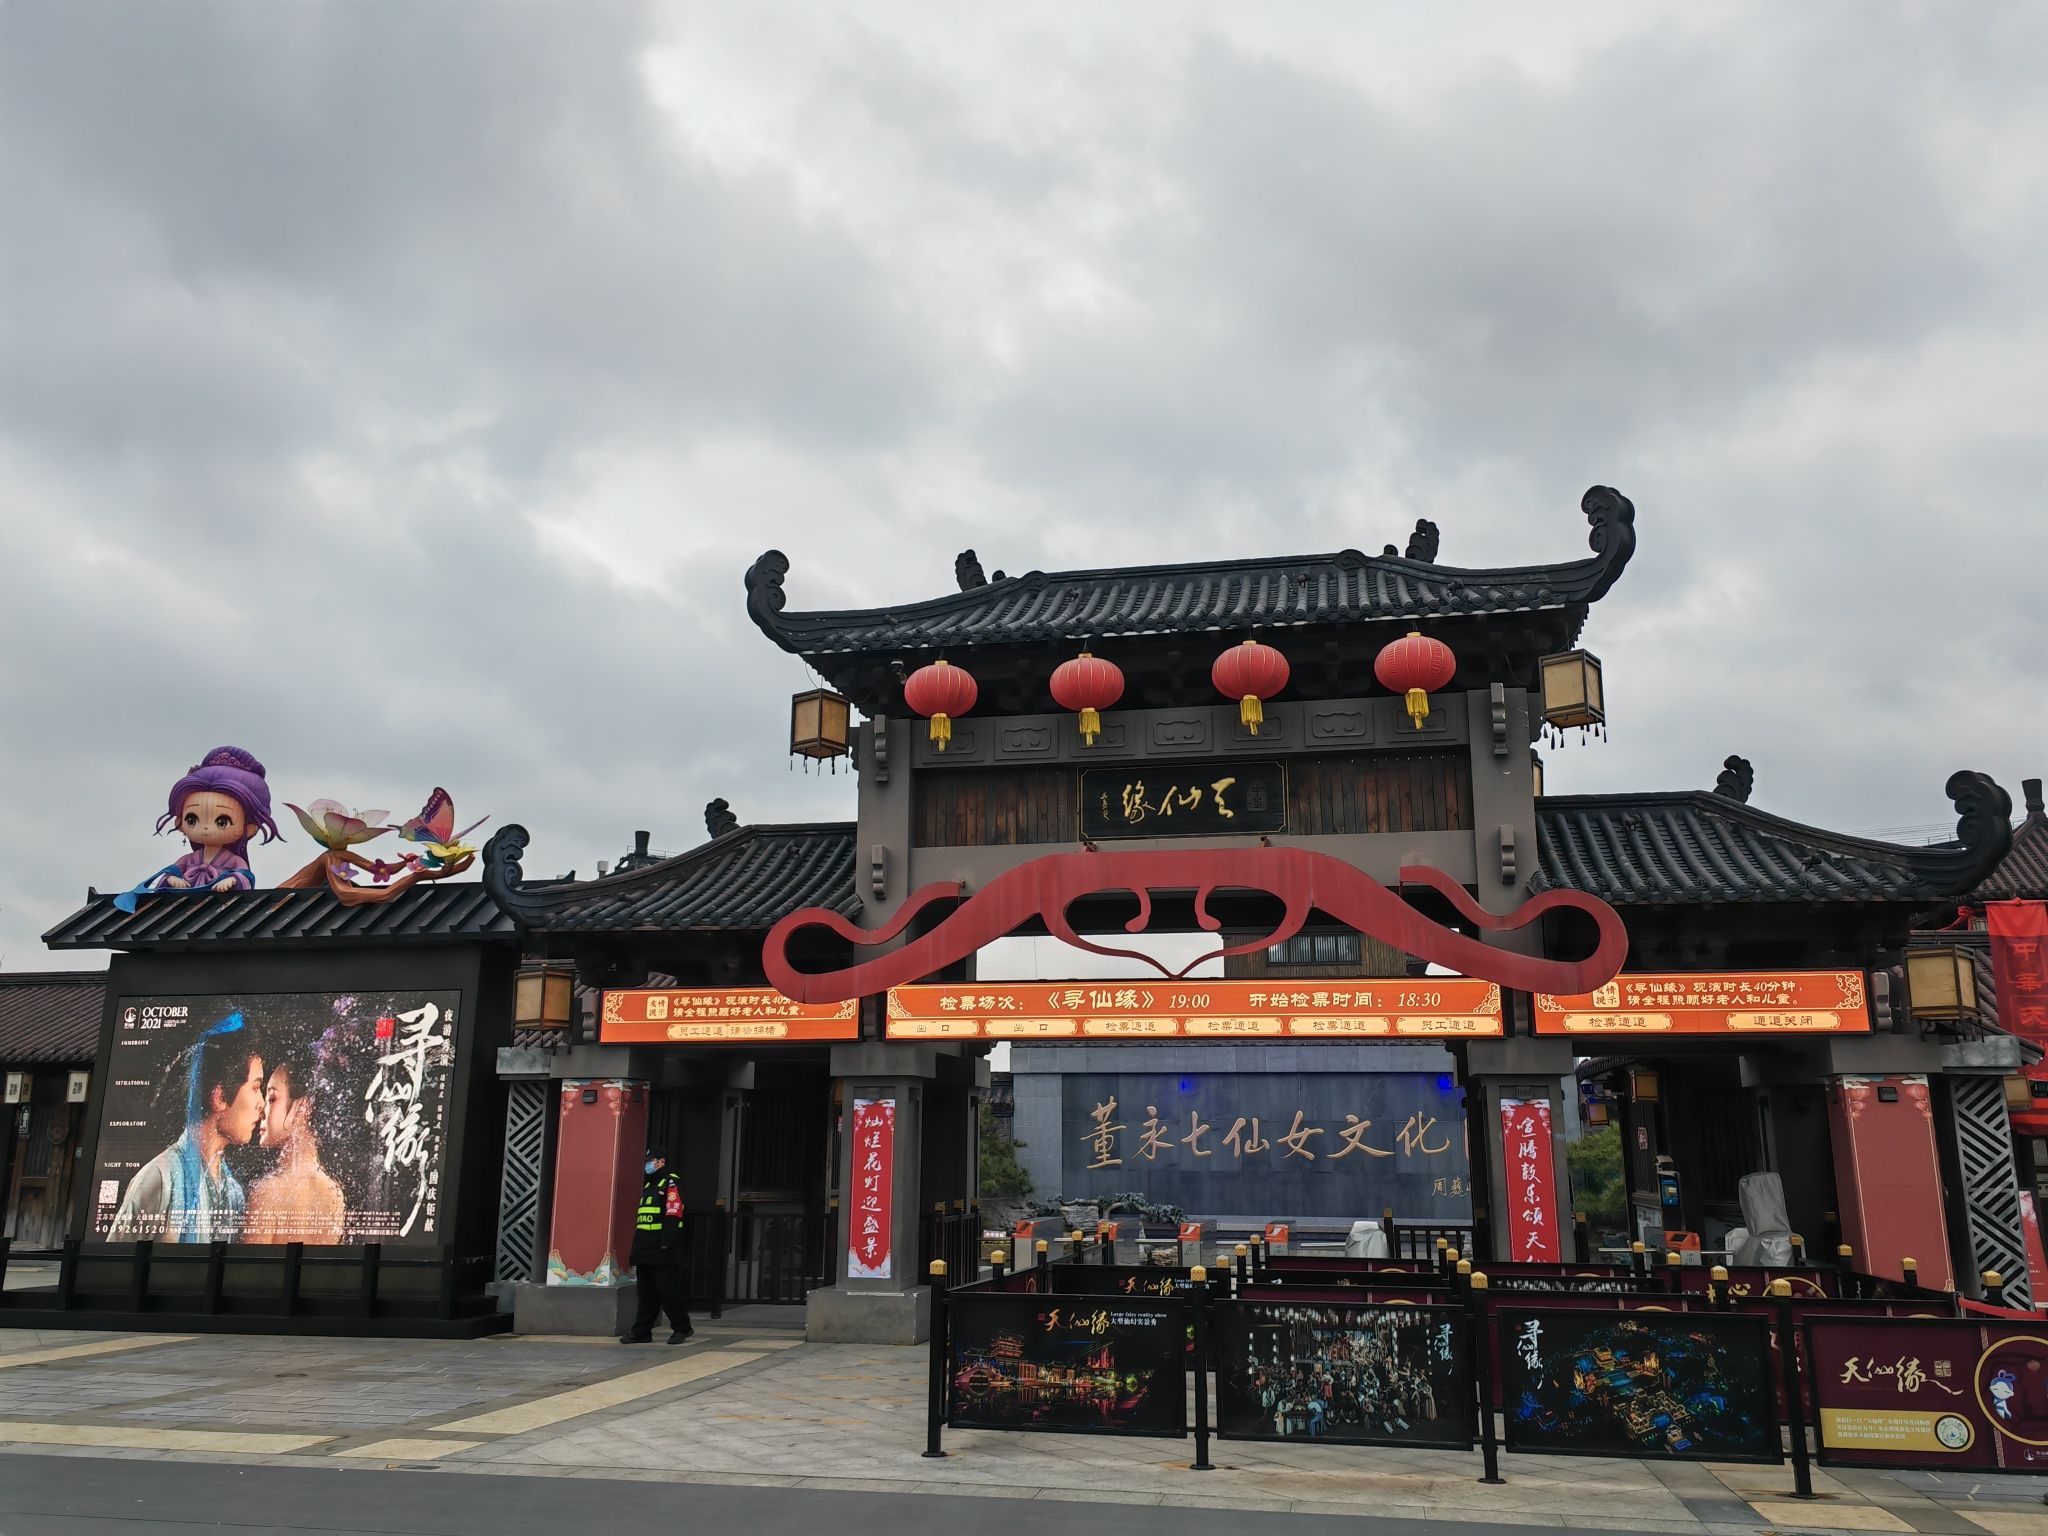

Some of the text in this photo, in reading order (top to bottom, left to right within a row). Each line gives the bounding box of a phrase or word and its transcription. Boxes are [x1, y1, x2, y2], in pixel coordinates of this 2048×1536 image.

[1048, 989, 1155, 1010] 《寻仙缘》
[1168, 994, 1210, 1009] 19:00
[1398, 992, 1441, 1007] 18:30
[142, 1006, 189, 1018] OCTOBER
[140, 1018, 162, 1029] 2021
[1105, 1021, 1156, 1032] 检票通道
[1207, 1020, 1260, 1031] 检票通道
[1312, 1020, 1366, 1031] 检票通道
[1421, 1019, 1477, 1031] 员工通道
[1588, 1017, 1647, 1028] 检票通道
[1753, 1015, 1813, 1026] 通道关闭
[1080, 1095, 1471, 1170] 董永七仙女文化
[860, 1115, 884, 1259] 灿烂花灯迎盛景
[1516, 1116, 1547, 1262] 喧腾鼓乐颂天
[1045, 1308, 1110, 1335] 天仙缘
